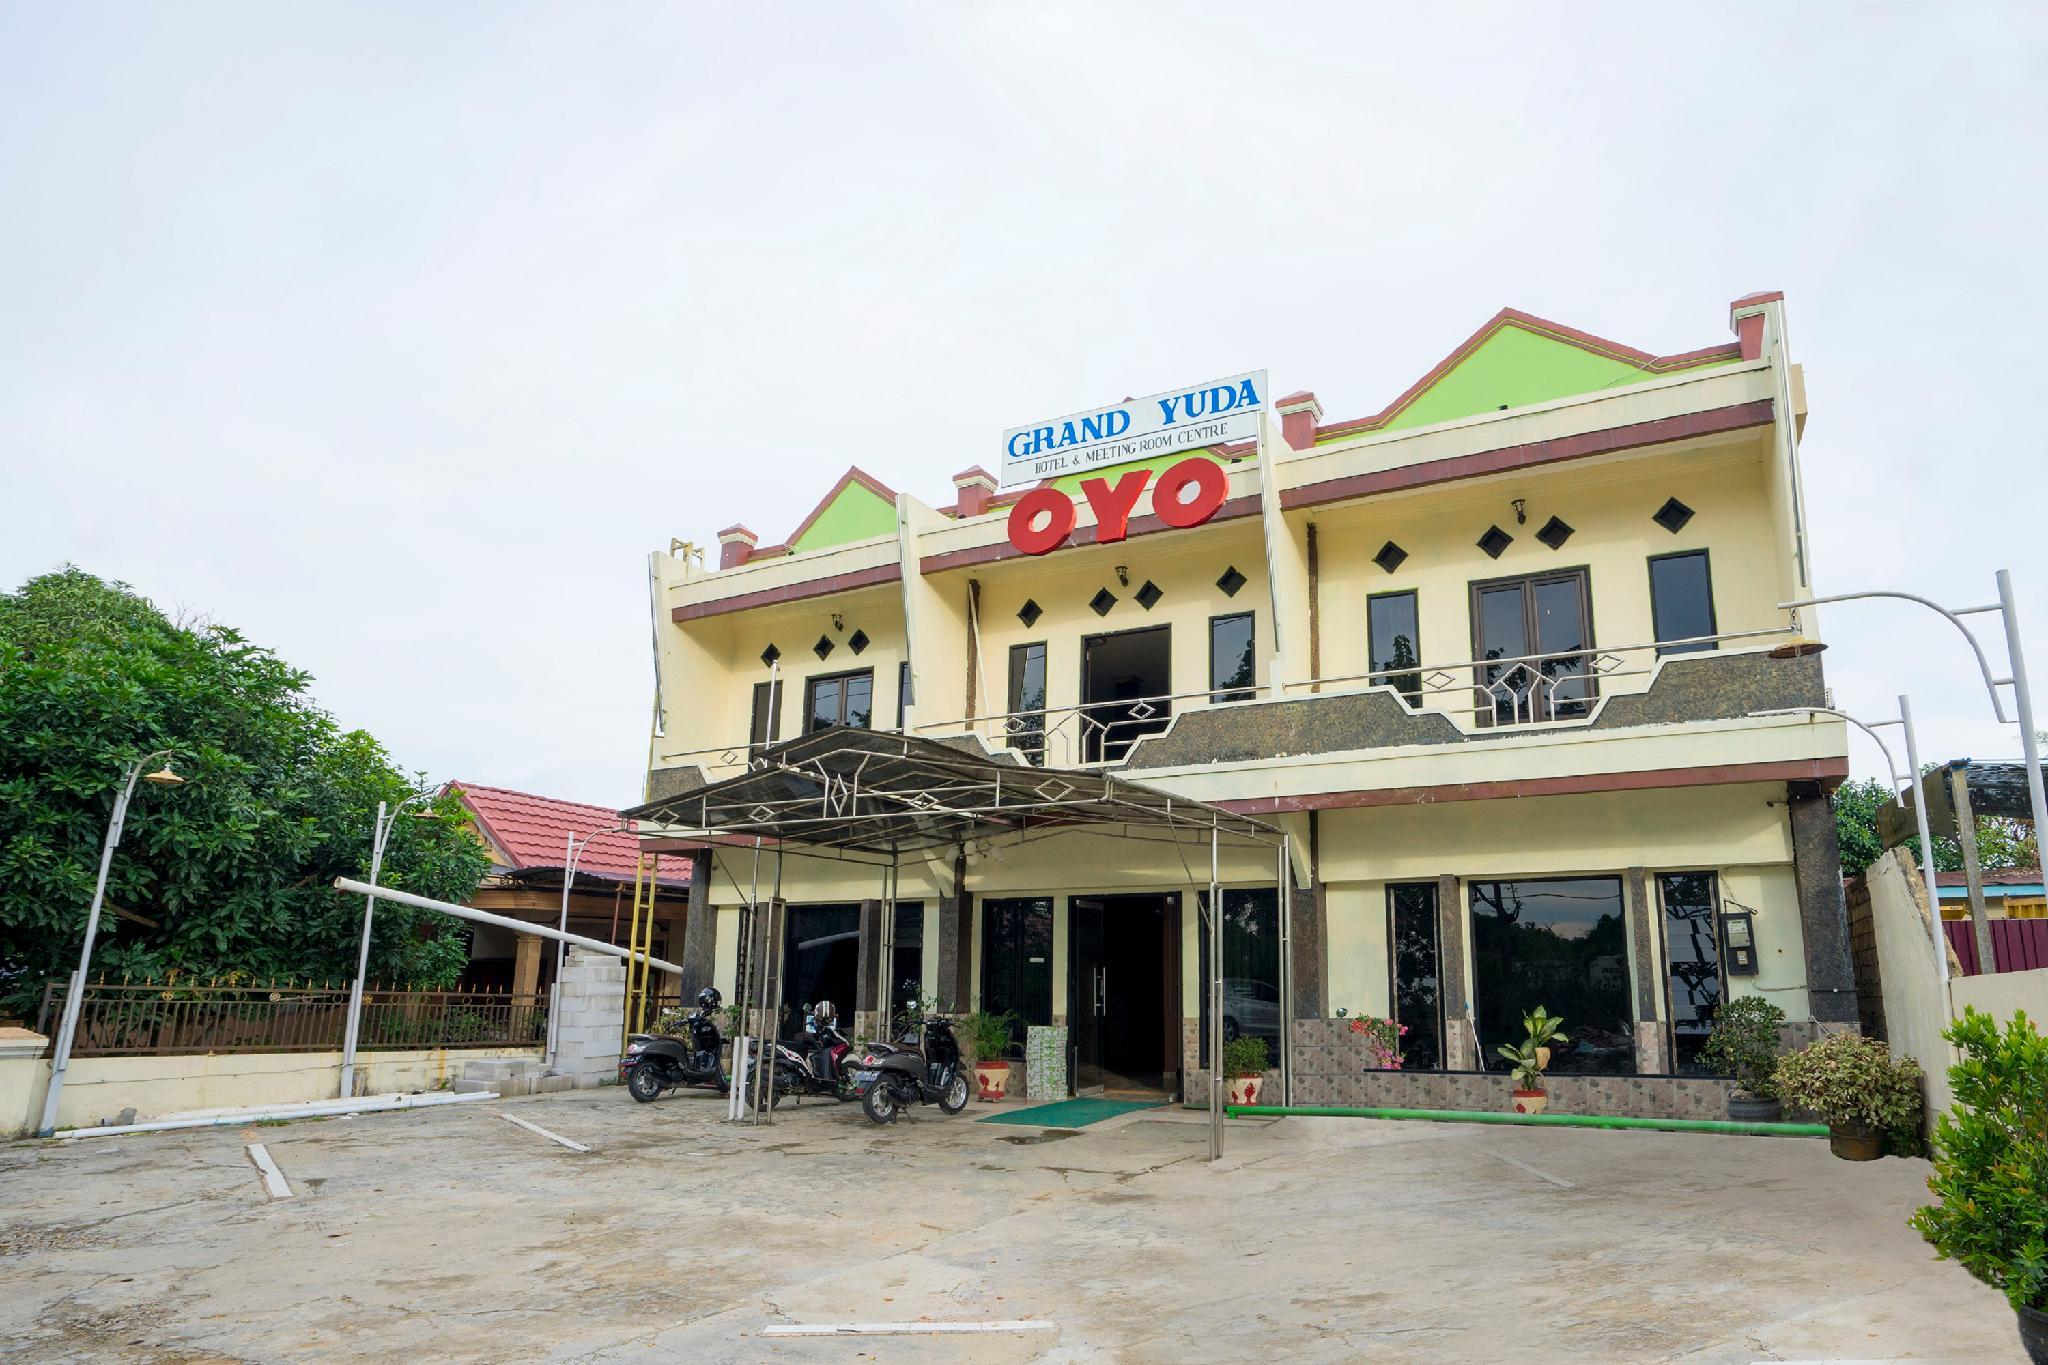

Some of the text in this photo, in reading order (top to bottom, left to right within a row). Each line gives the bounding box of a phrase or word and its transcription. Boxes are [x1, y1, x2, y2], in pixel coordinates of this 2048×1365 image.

[1008, 378, 1261, 458] GRAND YUDA
[1035, 422, 1228, 474] HOTEL & MEETING ROOM CENTRE
[1008, 457, 1230, 556] OYO
